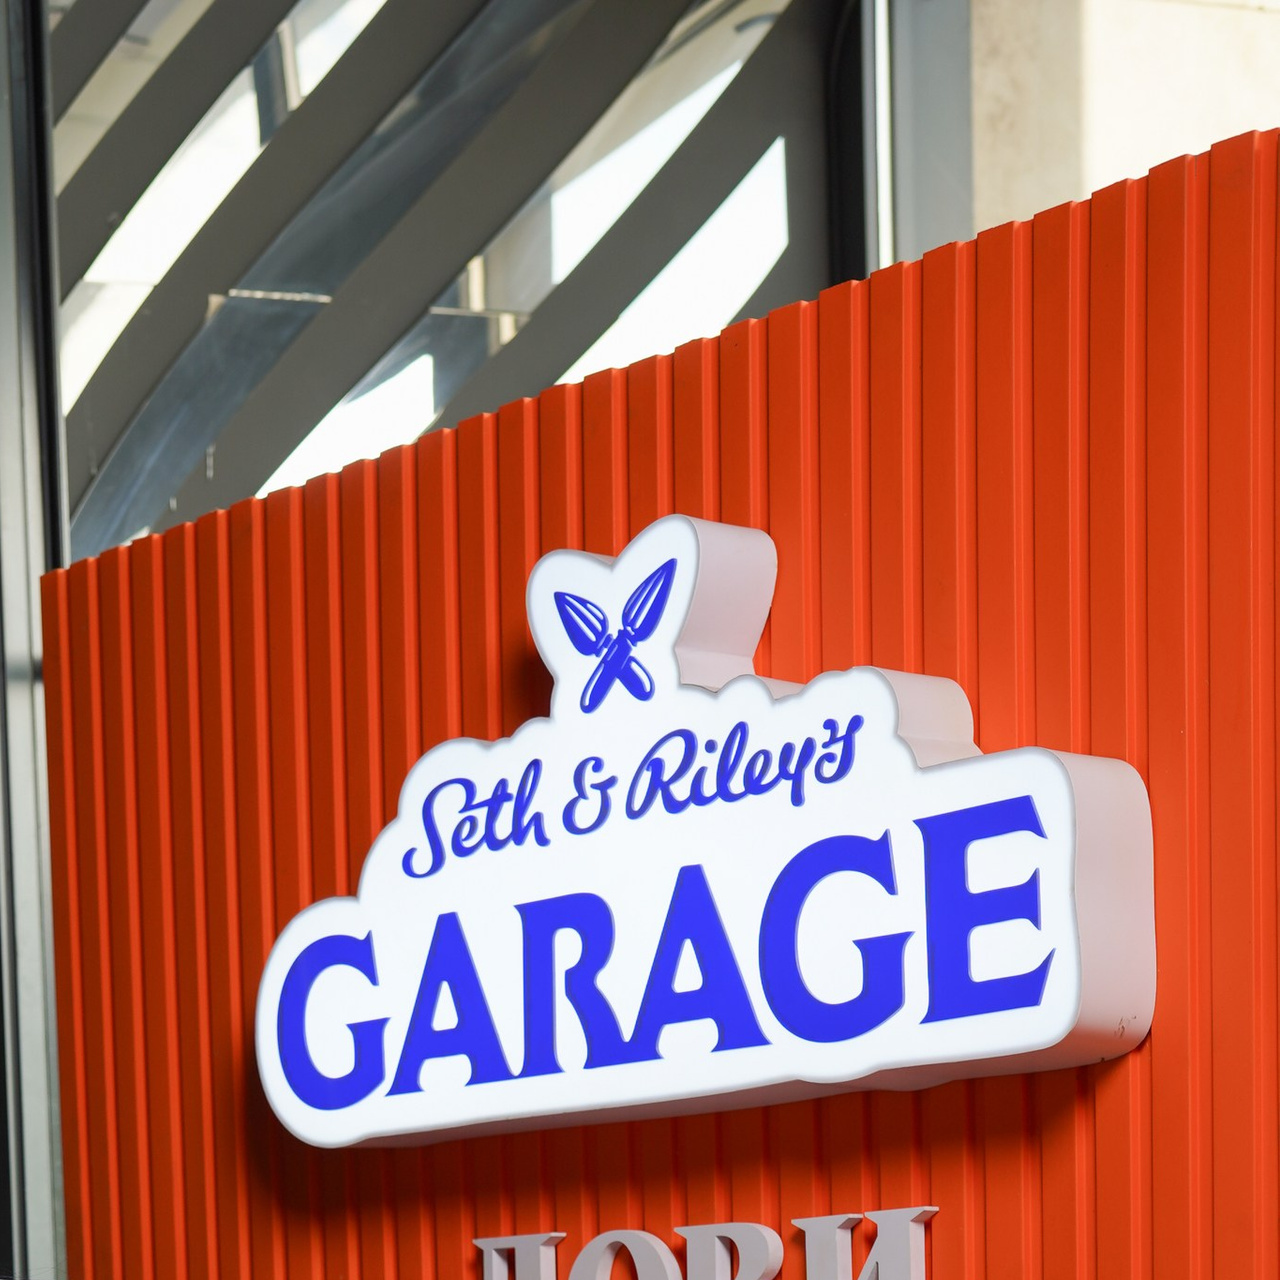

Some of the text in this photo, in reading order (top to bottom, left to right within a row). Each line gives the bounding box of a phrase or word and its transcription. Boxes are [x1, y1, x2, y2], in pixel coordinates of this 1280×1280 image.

[402, 714, 866, 879] Seth & Riley's
[277, 794, 1056, 1111] GARAGE
